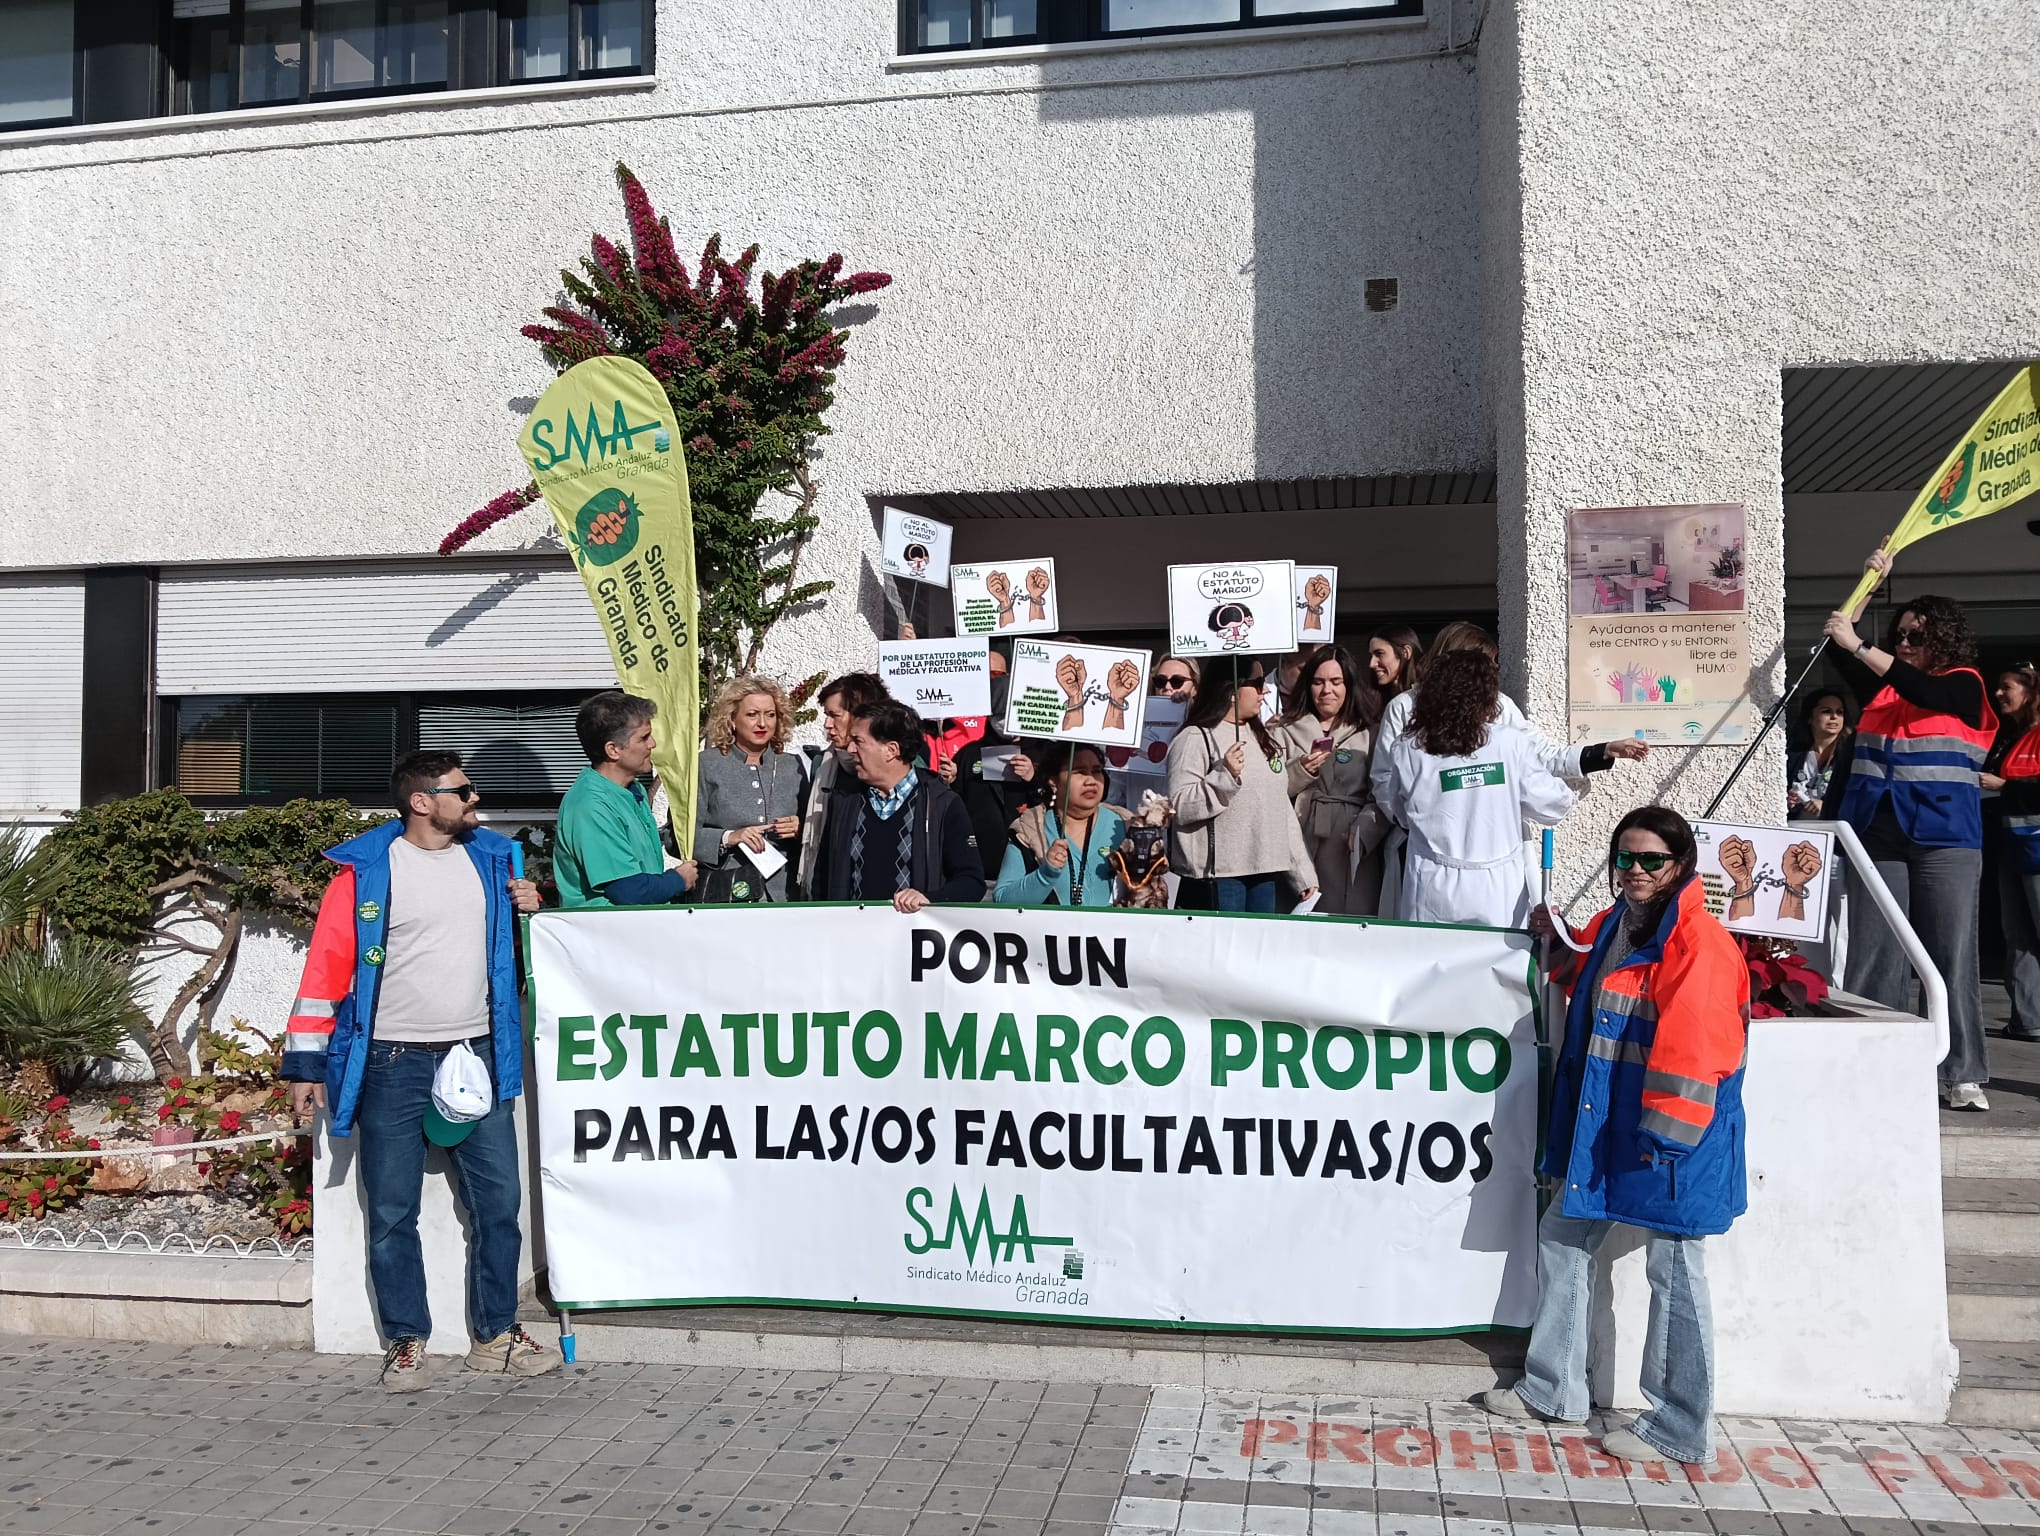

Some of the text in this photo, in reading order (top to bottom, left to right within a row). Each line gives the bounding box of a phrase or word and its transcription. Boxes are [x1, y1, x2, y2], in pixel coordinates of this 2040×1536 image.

[532, 400, 661, 471] SMA
[539, 452, 652, 489] Sindicato Médico Andaluz
[616, 457, 669, 480] Granada
[903, 523, 936, 536] ESTATUTO
[1203, 577, 1259, 588] ESTATUTO
[644, 544, 688, 648] Sindicato
[1212, 586, 1251, 595] MARCO!
[622, 559, 669, 673] Médico de
[597, 577, 639, 670] Granada
[1589, 623, 1736, 636] Ayúdanos a mantener
[1176, 634, 1206, 647] SMA
[1589, 639, 1612, 648] este
[1614, 637, 1659, 647] CENTRO
[1661, 639, 1668, 648] y
[1671, 638, 1682, 646] su
[914, 652, 956, 660] ESTATUTO
[957, 651, 987, 659] PROPIO
[1018, 643, 1049, 657] SMA
[1689, 649, 1737, 660] libre de
[924, 658, 968, 667] PROFESIÓN
[889, 668, 920, 676] MÉDICA
[928, 665, 981, 674] FACULTATIVA
[916, 688, 951, 701] SMA
[1023, 694, 1059, 702] medicina
[1018, 716, 1059, 725] ESTATUTO
[1021, 724, 1054, 733] MARCO!
[1447, 764, 1496, 777] ORGANIZACIÓN
[910, 928, 1128, 988] POR UN
[556, 1009, 1512, 1094] ESTATUTO MARCO PROPIO
[573, 1104, 1493, 1185] PARA LAS/OS FACULTATIVAS/OS
[904, 1182, 1074, 1268] SMA
[907, 1266, 1066, 1287] Sindicato Médico Andaluz
[1016, 1285, 1089, 1306] Granada
